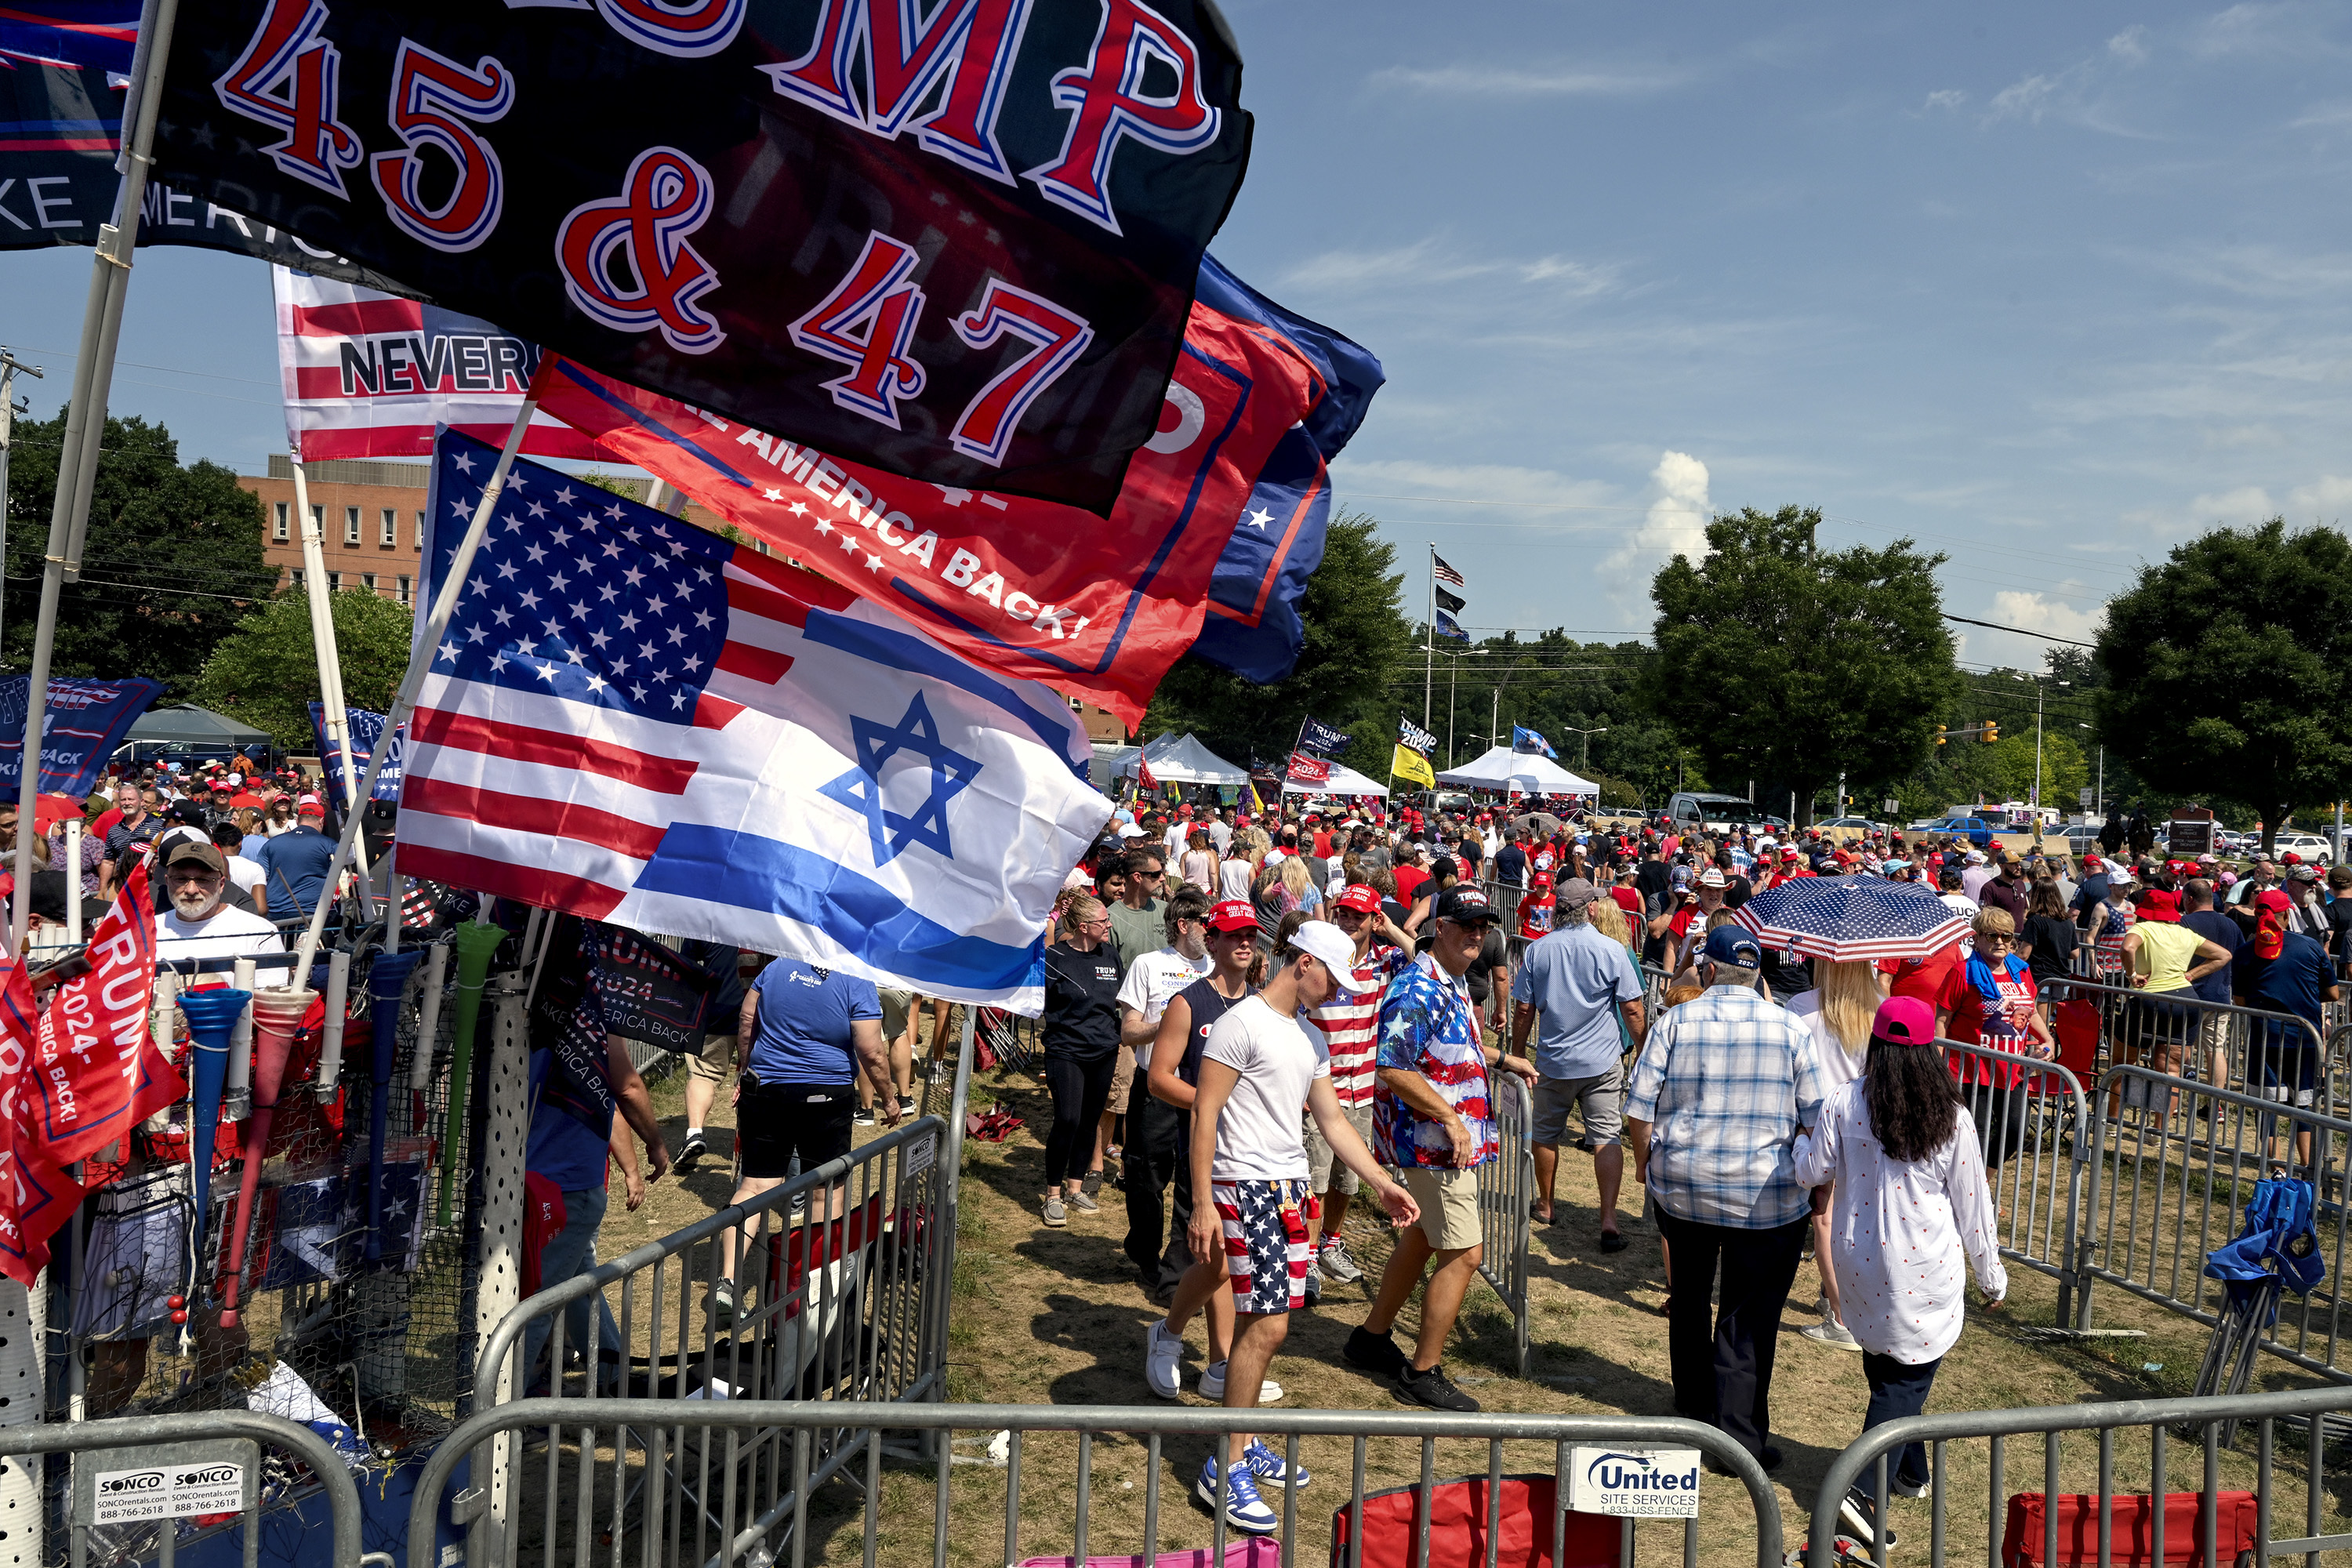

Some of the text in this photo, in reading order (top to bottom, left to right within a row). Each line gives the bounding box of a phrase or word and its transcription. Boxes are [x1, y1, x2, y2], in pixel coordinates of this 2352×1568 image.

[213, 0, 1095, 468] 45 & 47
[339, 336, 531, 396] NEVER
[735, 426, 937, 569] AMERICA
[941, 546, 1091, 641] BACK!
[1311, 722, 1347, 743] TRUMP
[1401, 716, 1438, 749] TRUMP
[1732, 939, 1751, 951] DONALD
[1738, 959, 1754, 967] 2024
[651, 1022, 691, 1044] BACK
[49, 1065, 78, 1124] BACK!
[586, 1075, 611, 1114] BAC
[911, 1139, 931, 1158] SONCO
[100, 1476, 161, 1493] SONCO
[174, 1469, 234, 1486] SONCO
[1601, 1465, 1697, 1491] United
[117, 1488, 148, 1497] Construction
[172, 1489, 241, 1502] SONCOrentals.com
[1600, 1494, 1696, 1506] SITE SERVICES
[97, 1496, 168, 1509] SONCOrentals.com
[175, 1498, 237, 1512] 888-766-2618
[1600, 1505, 1694, 1516] 1-833-USS-FENCE
[100, 1504, 164, 1519] 888-766-2618
